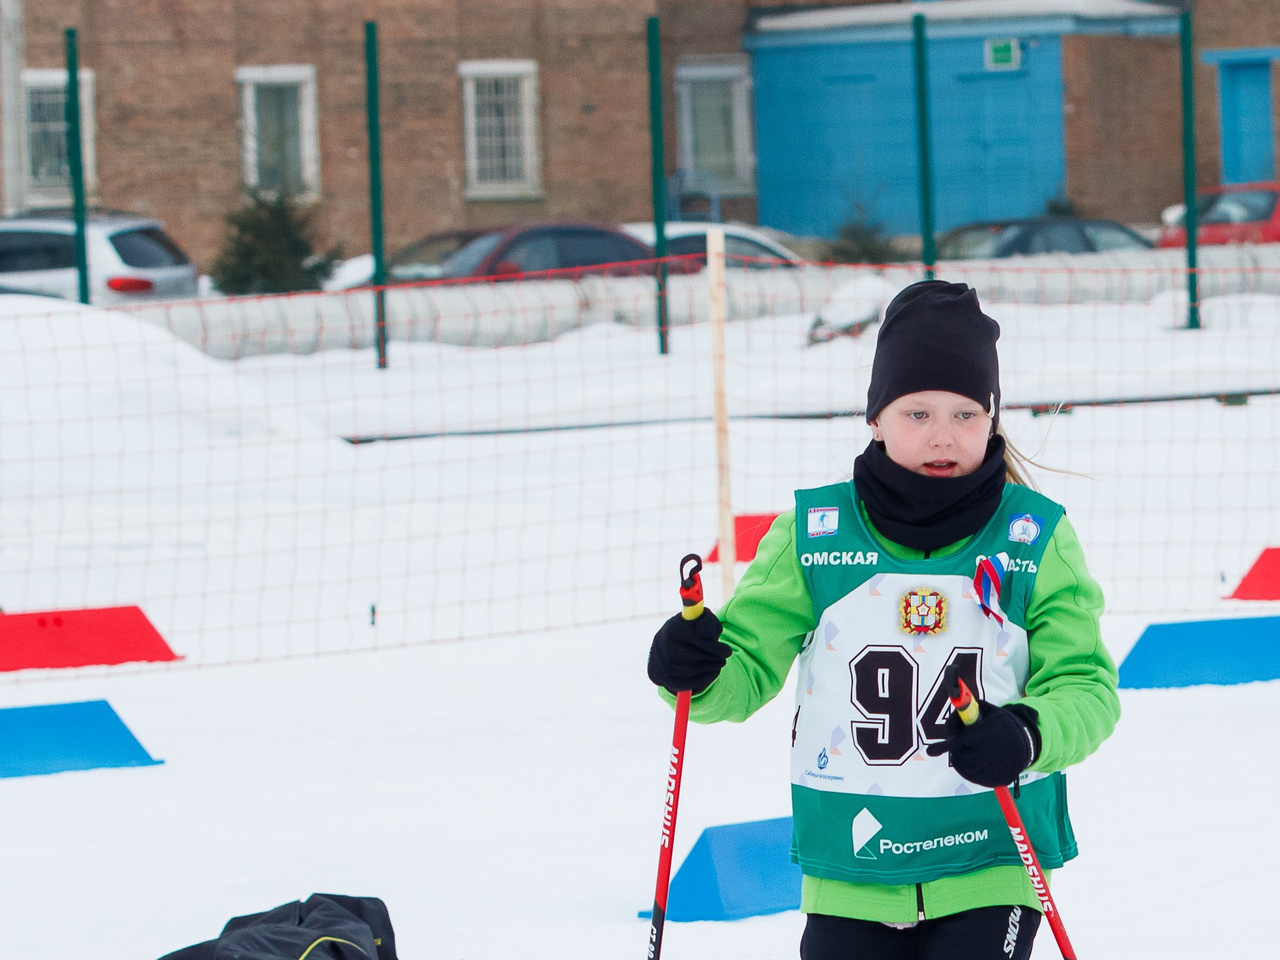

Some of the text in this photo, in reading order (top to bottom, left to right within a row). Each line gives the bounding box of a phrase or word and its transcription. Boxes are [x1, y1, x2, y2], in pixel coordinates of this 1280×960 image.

[800, 551, 879, 567] ОМСКАЯ
[660, 746, 680, 849] MADSHUS
[878, 828, 989, 856] Ростелеком
[1008, 825, 1053, 914] MADSHUS
